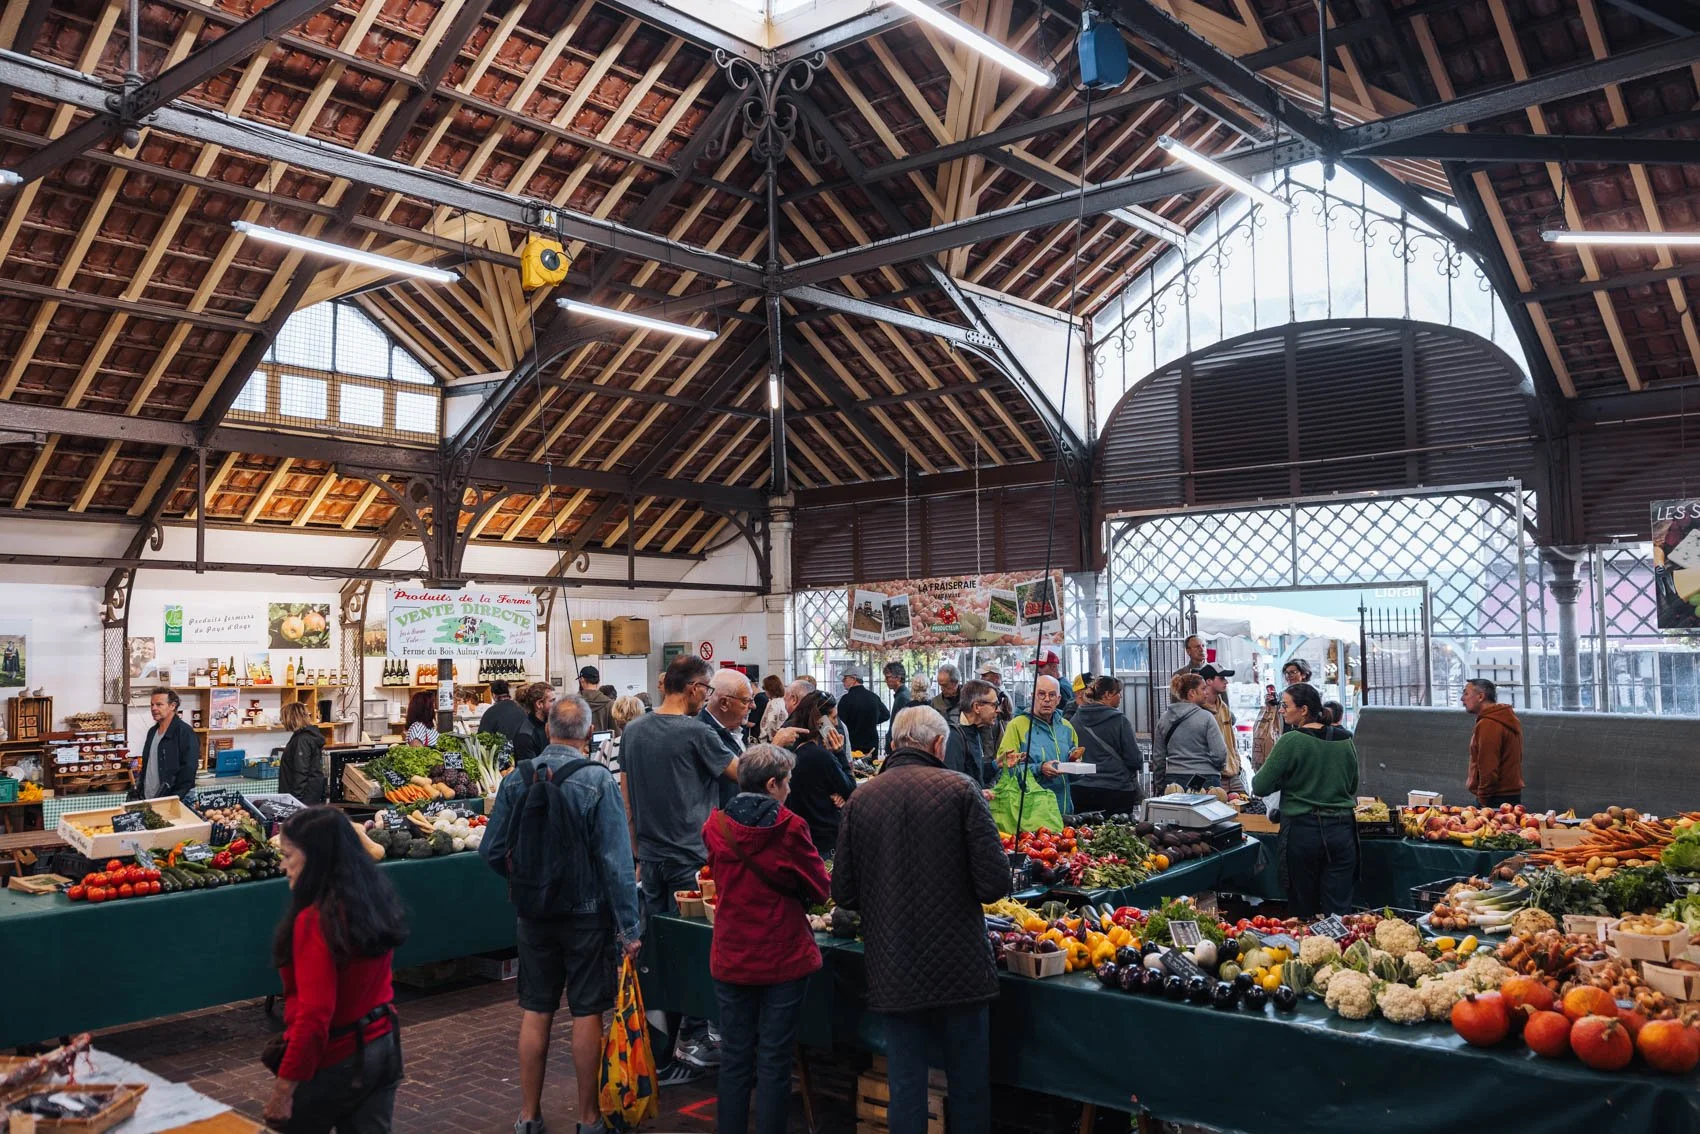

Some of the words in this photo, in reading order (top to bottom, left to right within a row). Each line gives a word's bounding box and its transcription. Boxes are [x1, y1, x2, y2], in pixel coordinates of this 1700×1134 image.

[1657, 506, 1686, 520] LES
[918, 583, 928, 594] LA
[929, 580, 977, 591] FRAISERAIE
[394, 588, 452, 601] Produits
[458, 594, 473, 602] de
[480, 594, 491, 603] la
[496, 594, 532, 605] Ferme
[188, 616, 221, 625] Produits
[395, 603, 455, 627] VENTE
[461, 602, 531, 629] DIRECTE
[931, 624, 960, 632] PRODUCTEUR
[403, 647, 425, 655] Ferme
[427, 647, 437, 655] du
[440, 647, 454, 655] Bois
